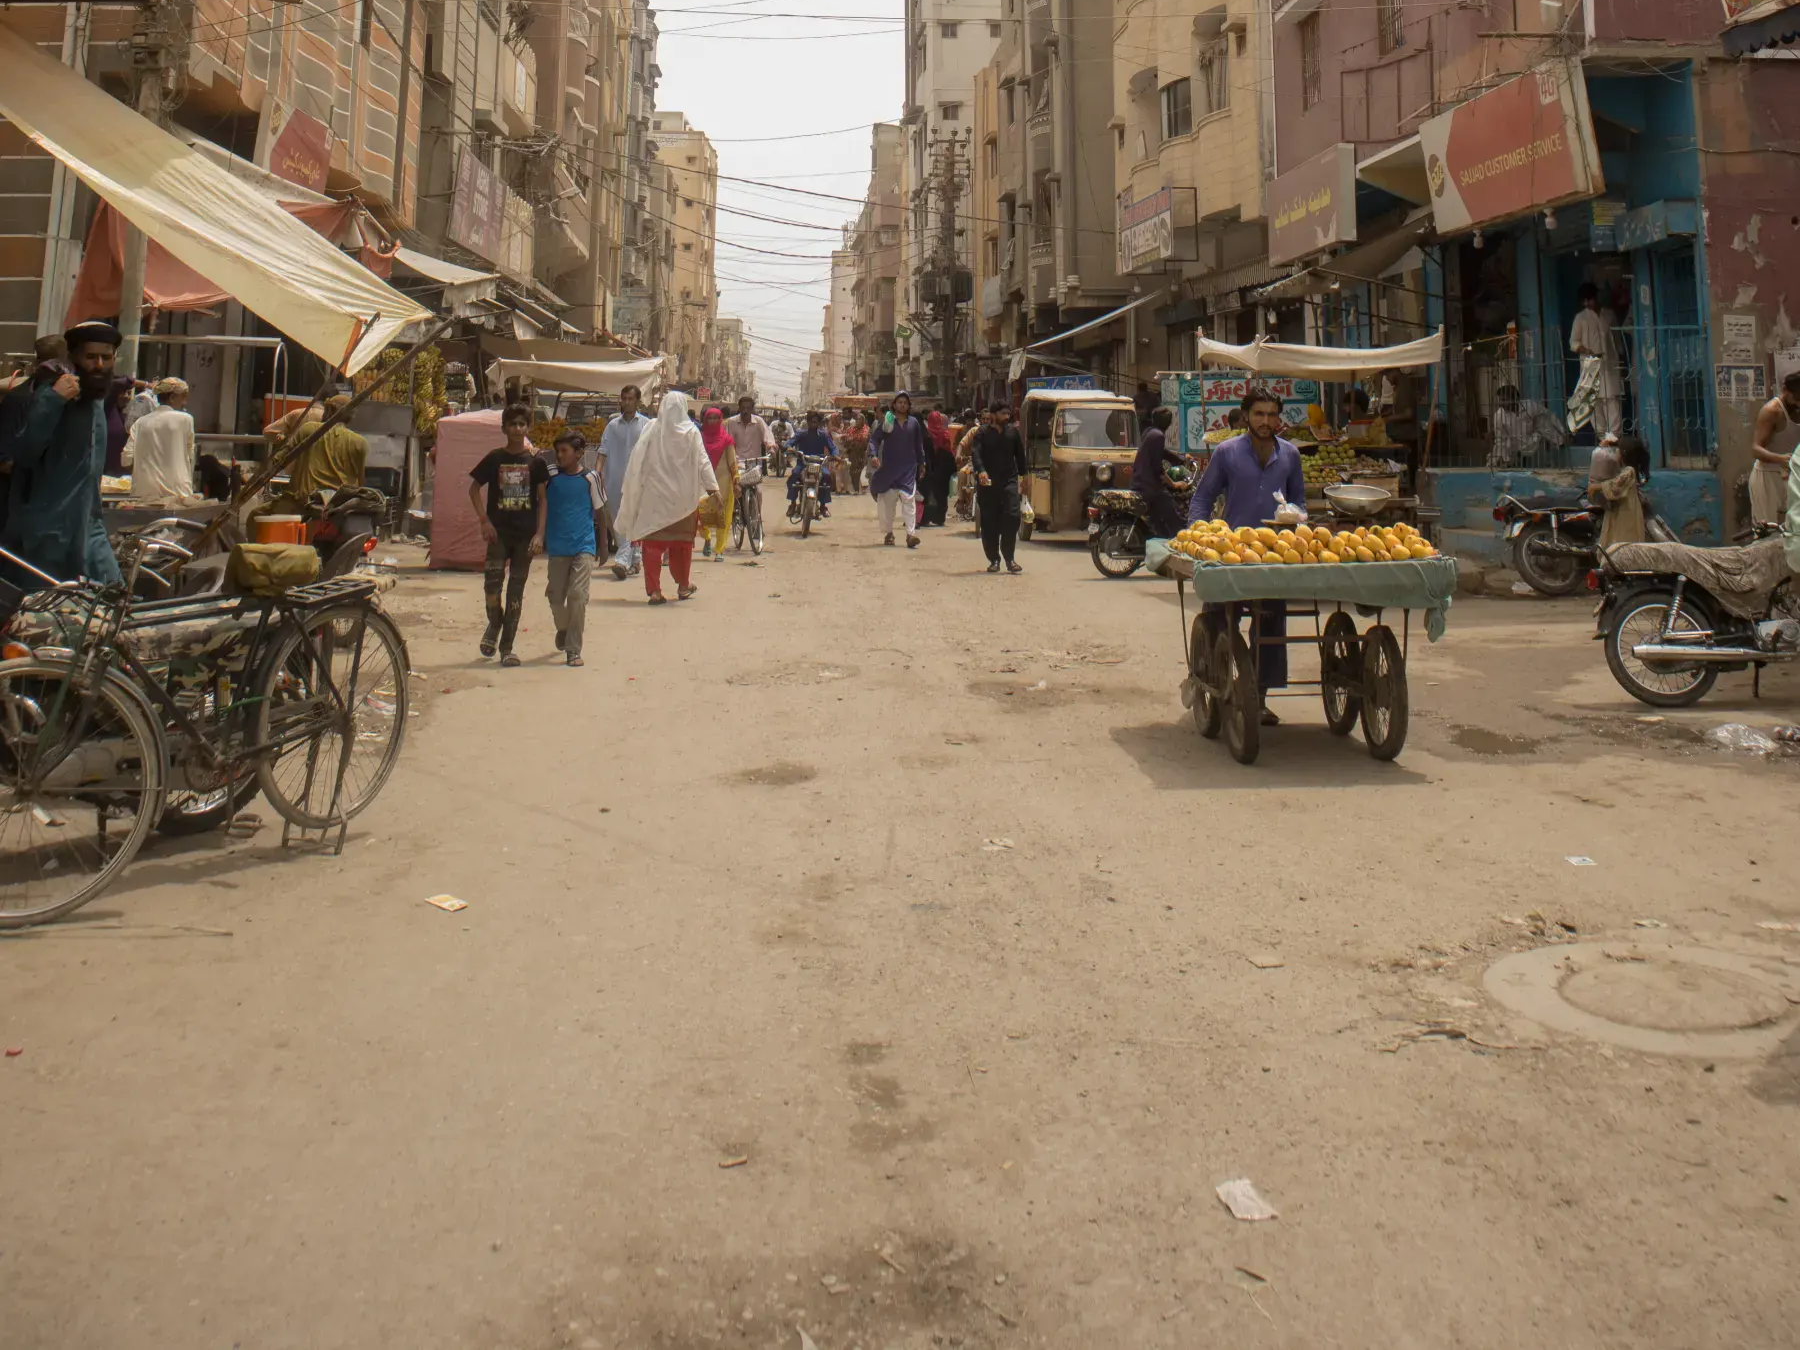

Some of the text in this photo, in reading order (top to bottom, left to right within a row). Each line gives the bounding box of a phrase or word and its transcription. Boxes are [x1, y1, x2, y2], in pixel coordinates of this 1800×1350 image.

[1460, 132, 1562, 186] SAJJAD CUSTOMER SERVICE
